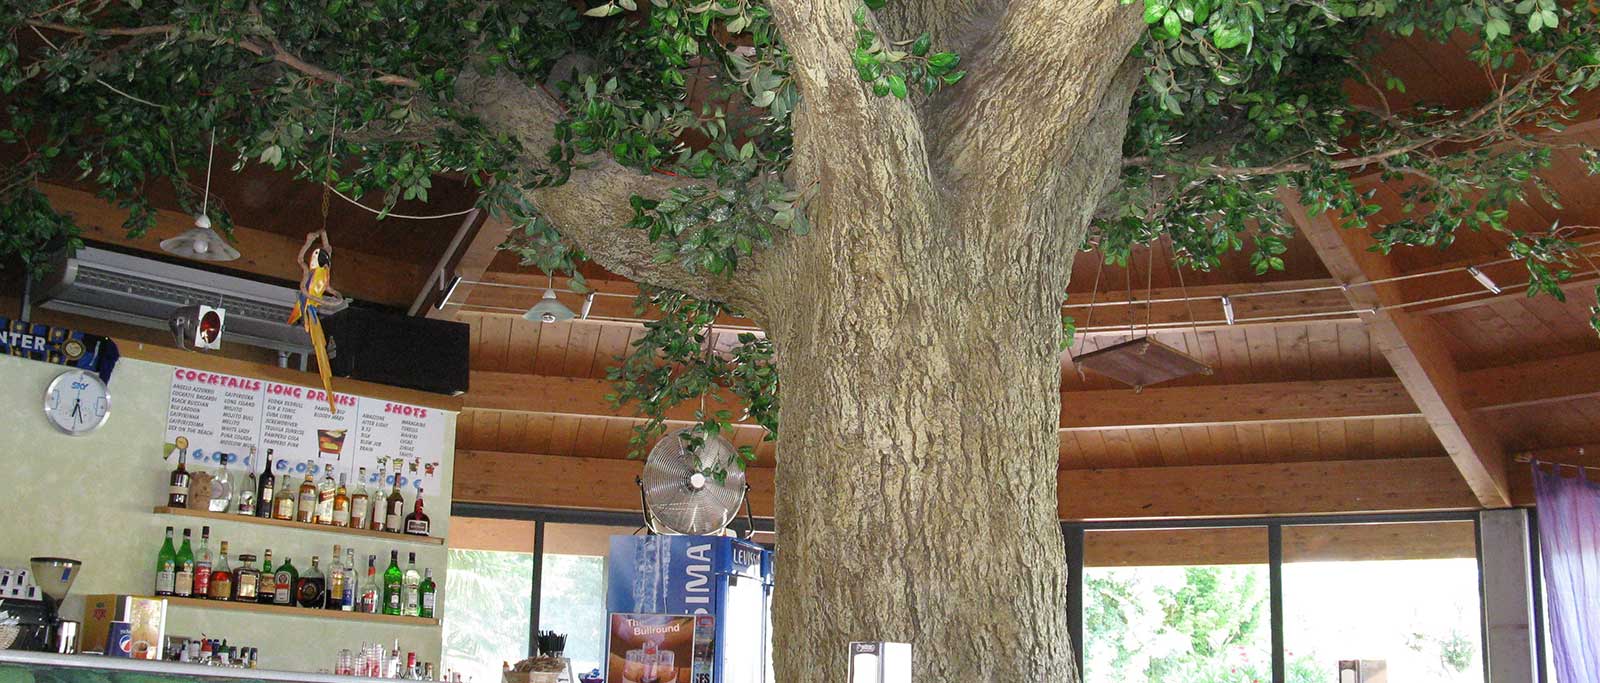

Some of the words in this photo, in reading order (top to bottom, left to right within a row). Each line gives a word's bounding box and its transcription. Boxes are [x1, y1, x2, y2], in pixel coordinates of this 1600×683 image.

[175, 369, 261, 391] COCKTAILS
[171, 397, 186, 405] BLACK
[187, 399, 209, 408] RUSSIAN
[267, 383, 302, 399] LONG
[306, 389, 357, 407] DRNKS
[384, 402, 427, 419] SHOTS
[633, 624, 680, 637] Bullround
